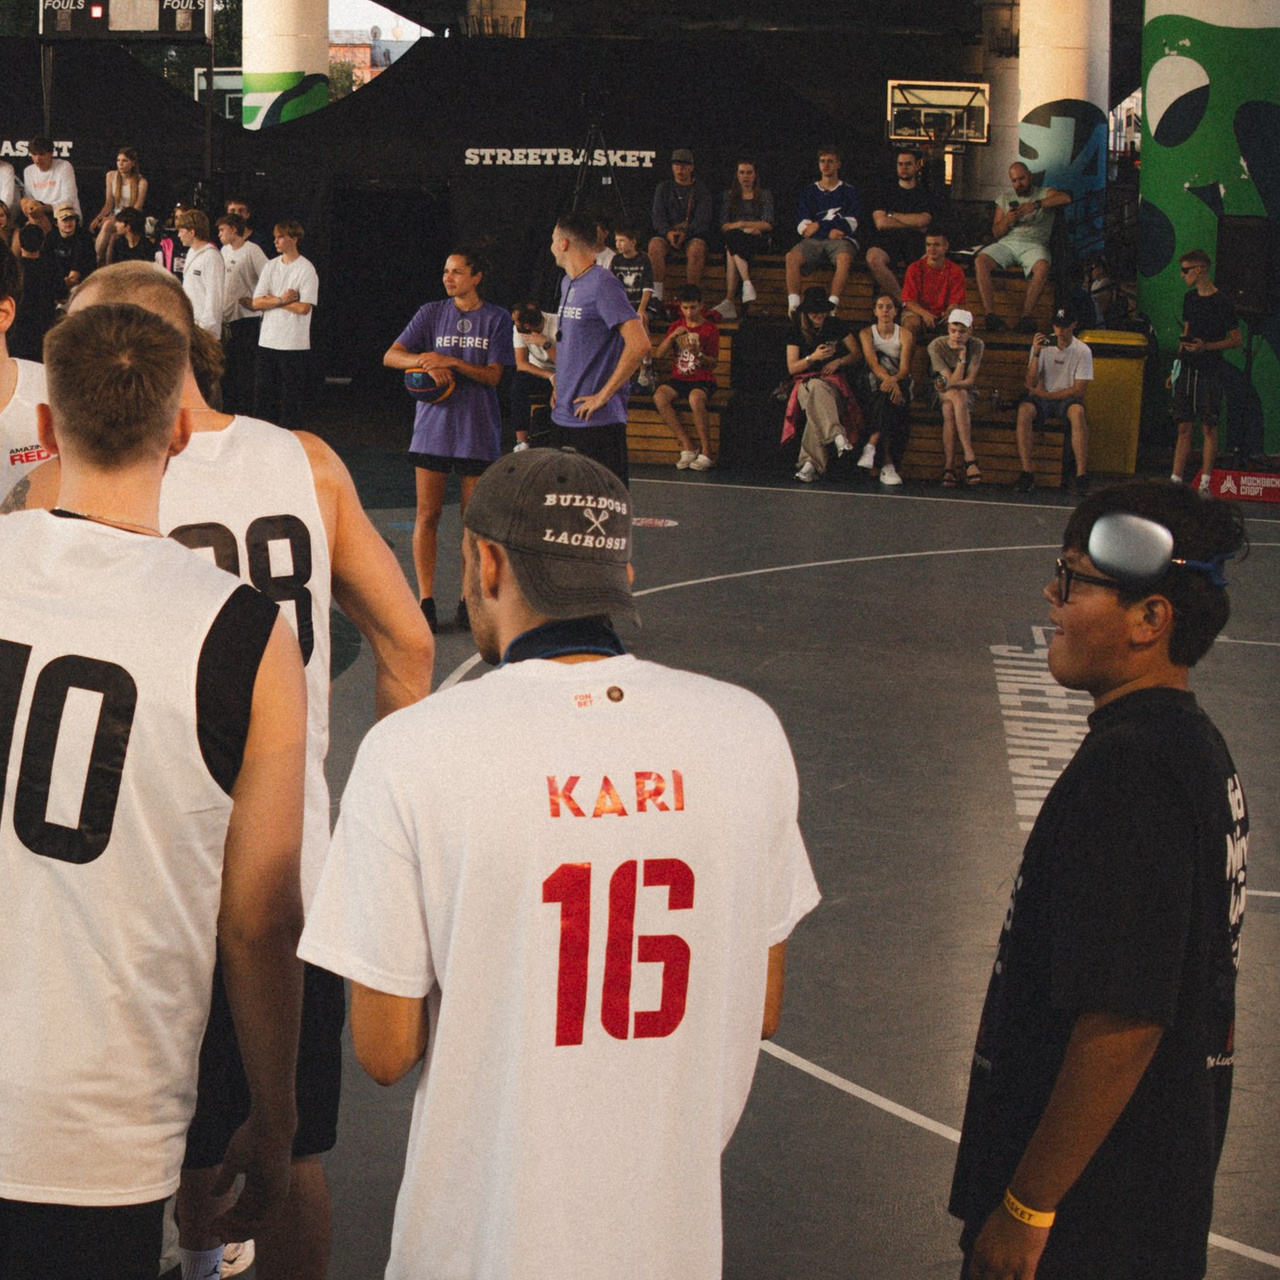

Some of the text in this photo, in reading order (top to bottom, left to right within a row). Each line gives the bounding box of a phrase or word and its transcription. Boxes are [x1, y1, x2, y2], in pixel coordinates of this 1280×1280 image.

[45, 0, 205, 10] FOULS FOULS
[436, 336, 489, 350] REFEREE
[9, 444, 42, 454] AMAZIN
[10, 450, 51, 466] RED
[1240, 476, 1280, 488] МОСКОВСК
[1240, 486, 1263, 496] СПОРТ
[543, 494, 627, 515] BULLDOGS
[546, 769, 686, 818] KARI
[542, 858, 696, 1047] 16
